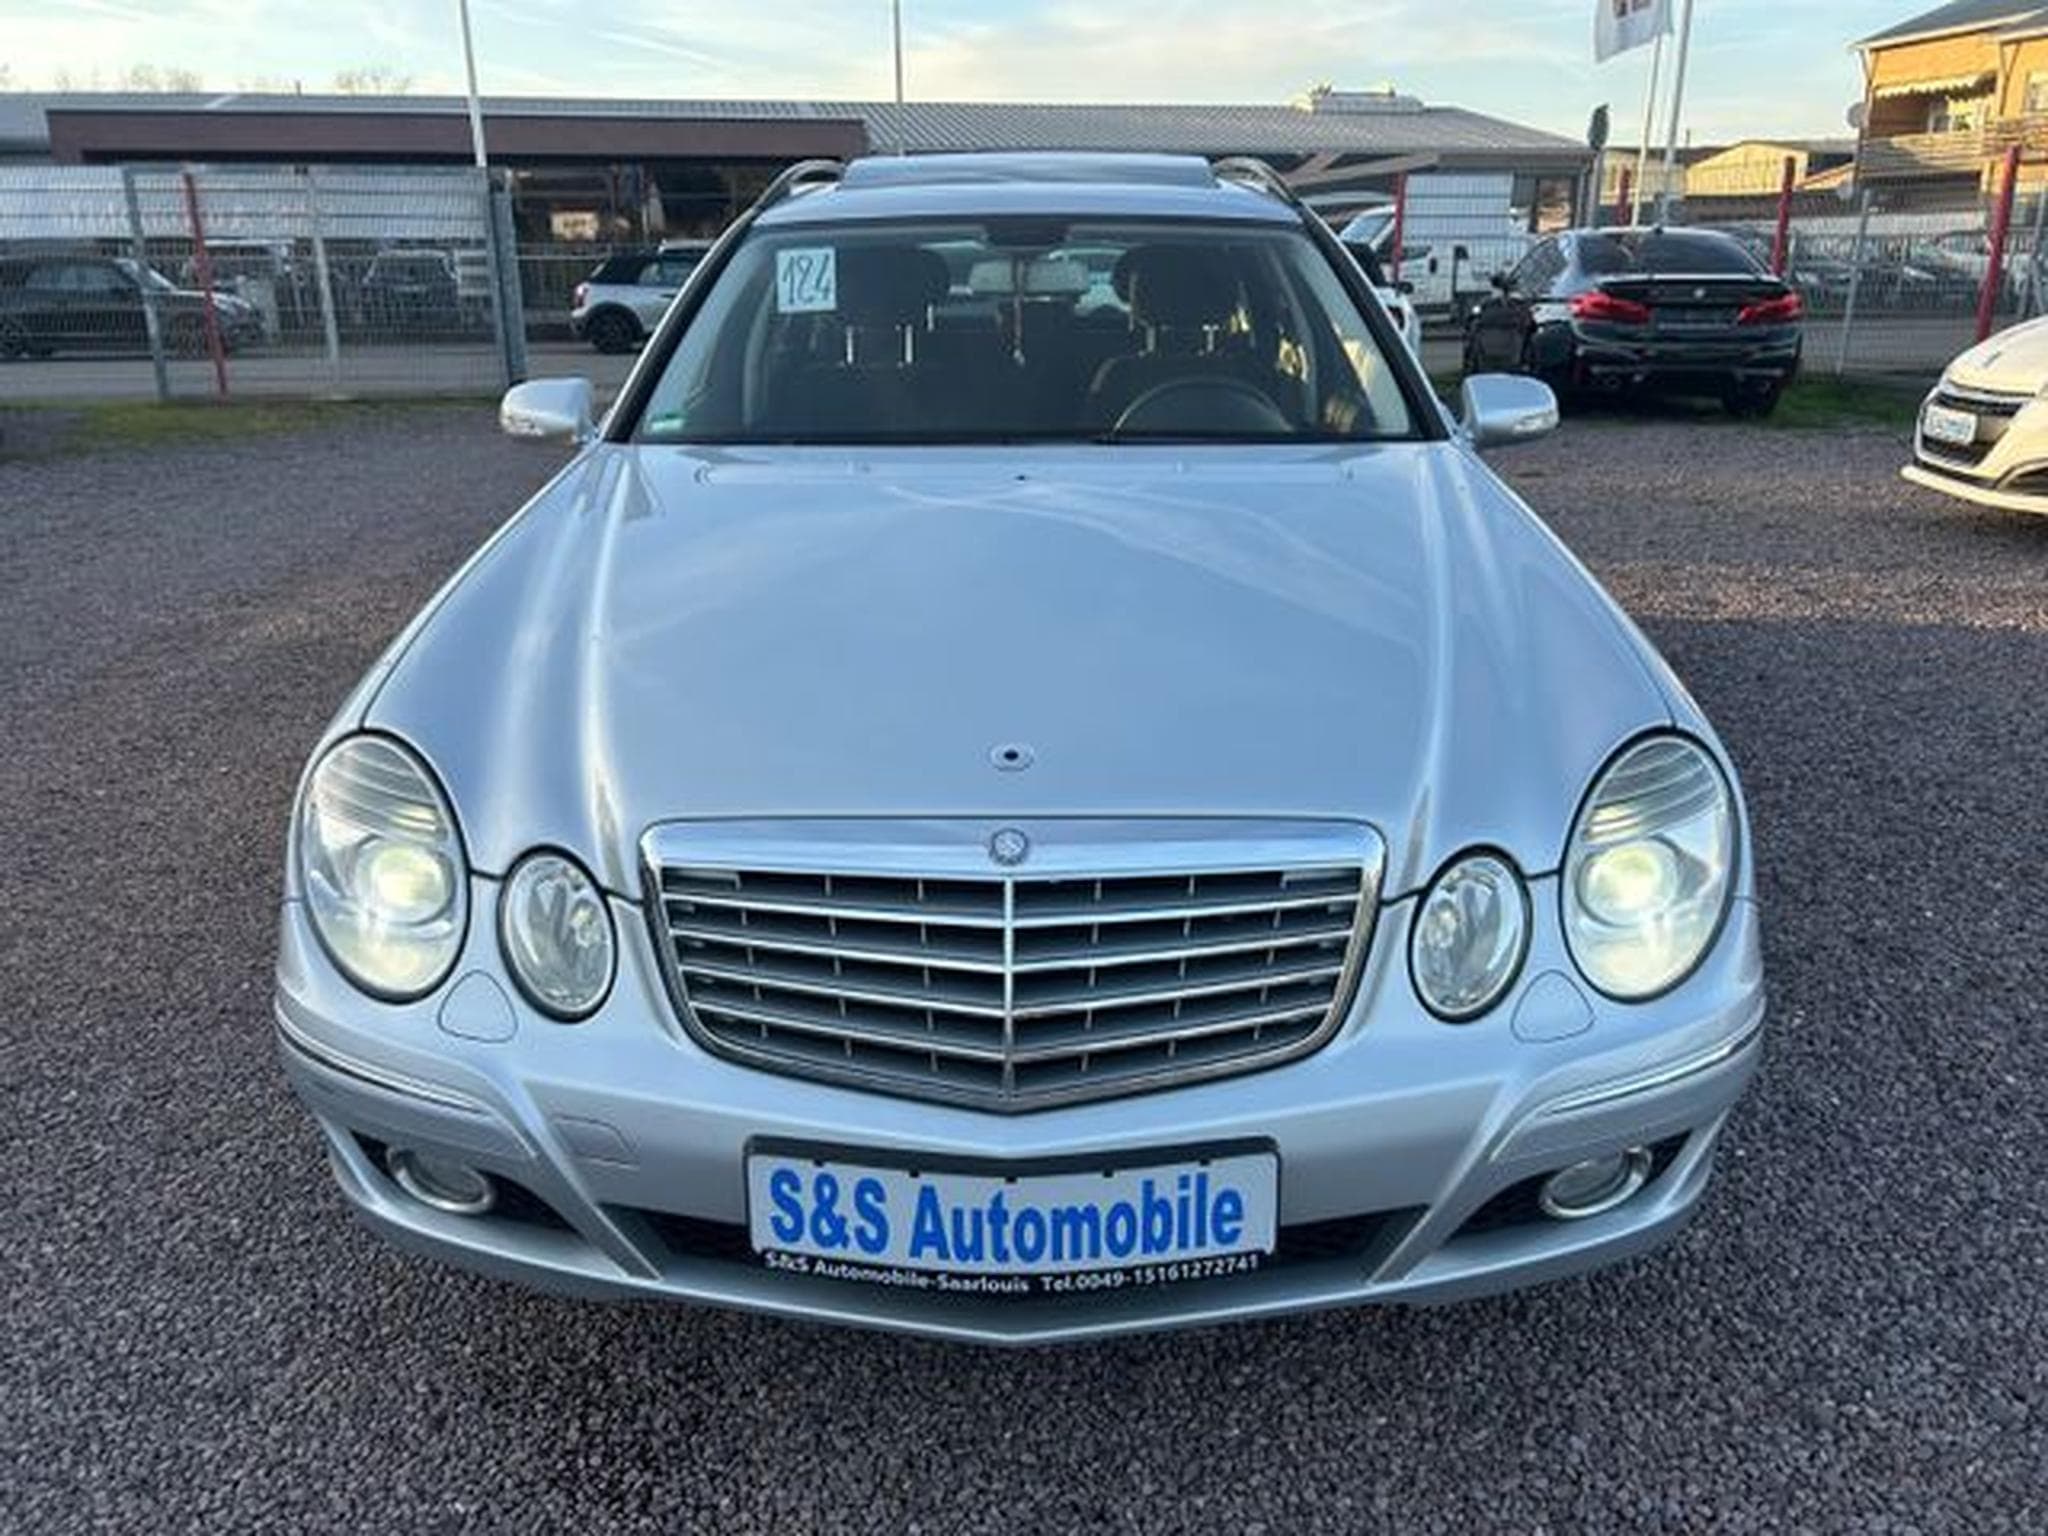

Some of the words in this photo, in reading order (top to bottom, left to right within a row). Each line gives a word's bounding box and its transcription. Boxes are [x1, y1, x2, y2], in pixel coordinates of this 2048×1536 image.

[770, 1168, 889, 1255] S&S
[909, 1173, 1243, 1264] Automobile
[764, 1252, 809, 1274] S&S
